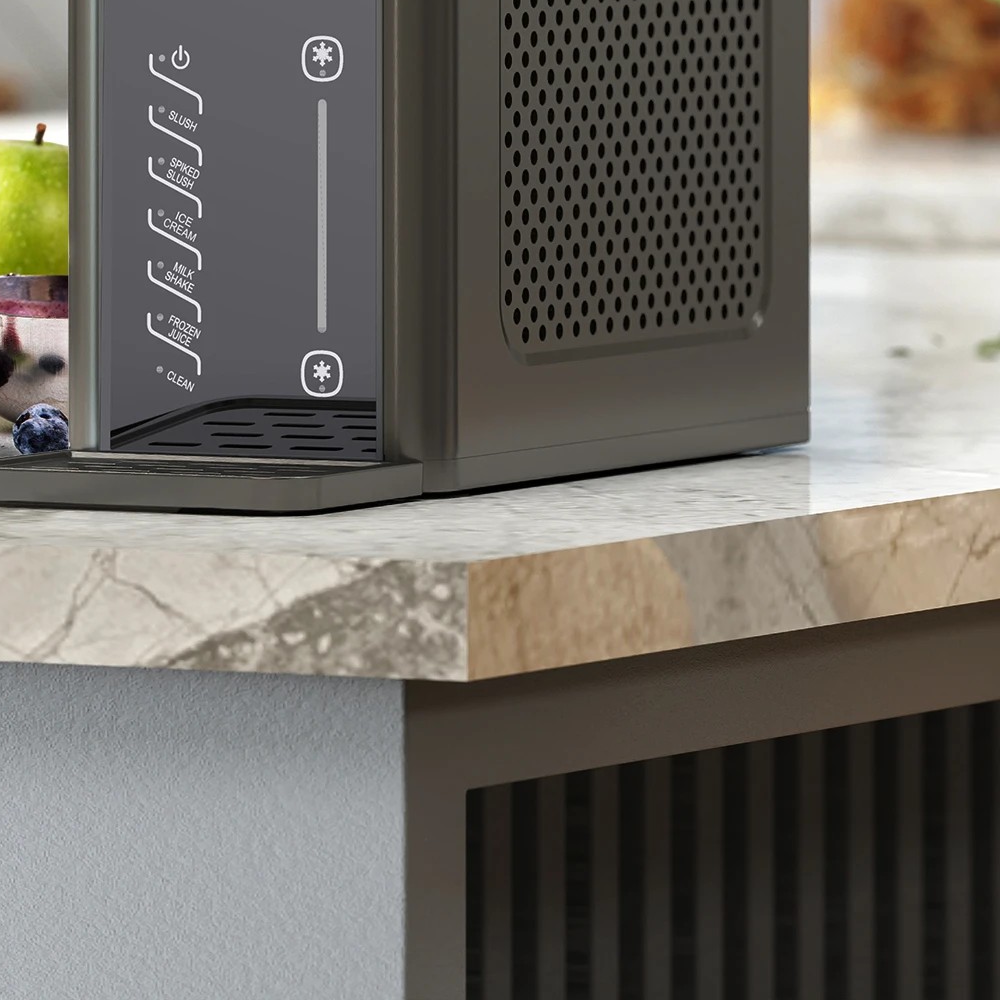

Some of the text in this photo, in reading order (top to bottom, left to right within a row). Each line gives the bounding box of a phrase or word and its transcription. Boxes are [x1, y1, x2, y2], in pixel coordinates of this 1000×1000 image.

[168, 110, 198, 132] SLUSH
[166, 168, 195, 190] SLUSH
[169, 157, 200, 180] SPIKED
[163, 218, 197, 243] CREAM
[175, 211, 194, 228] ICE
[164, 270, 195, 294] SHAKE
[172, 261, 195, 281] MILK
[168, 314, 201, 339] FROZEN
[168, 328, 193, 347] JUICE
[166, 370, 195, 392] CLEAN
